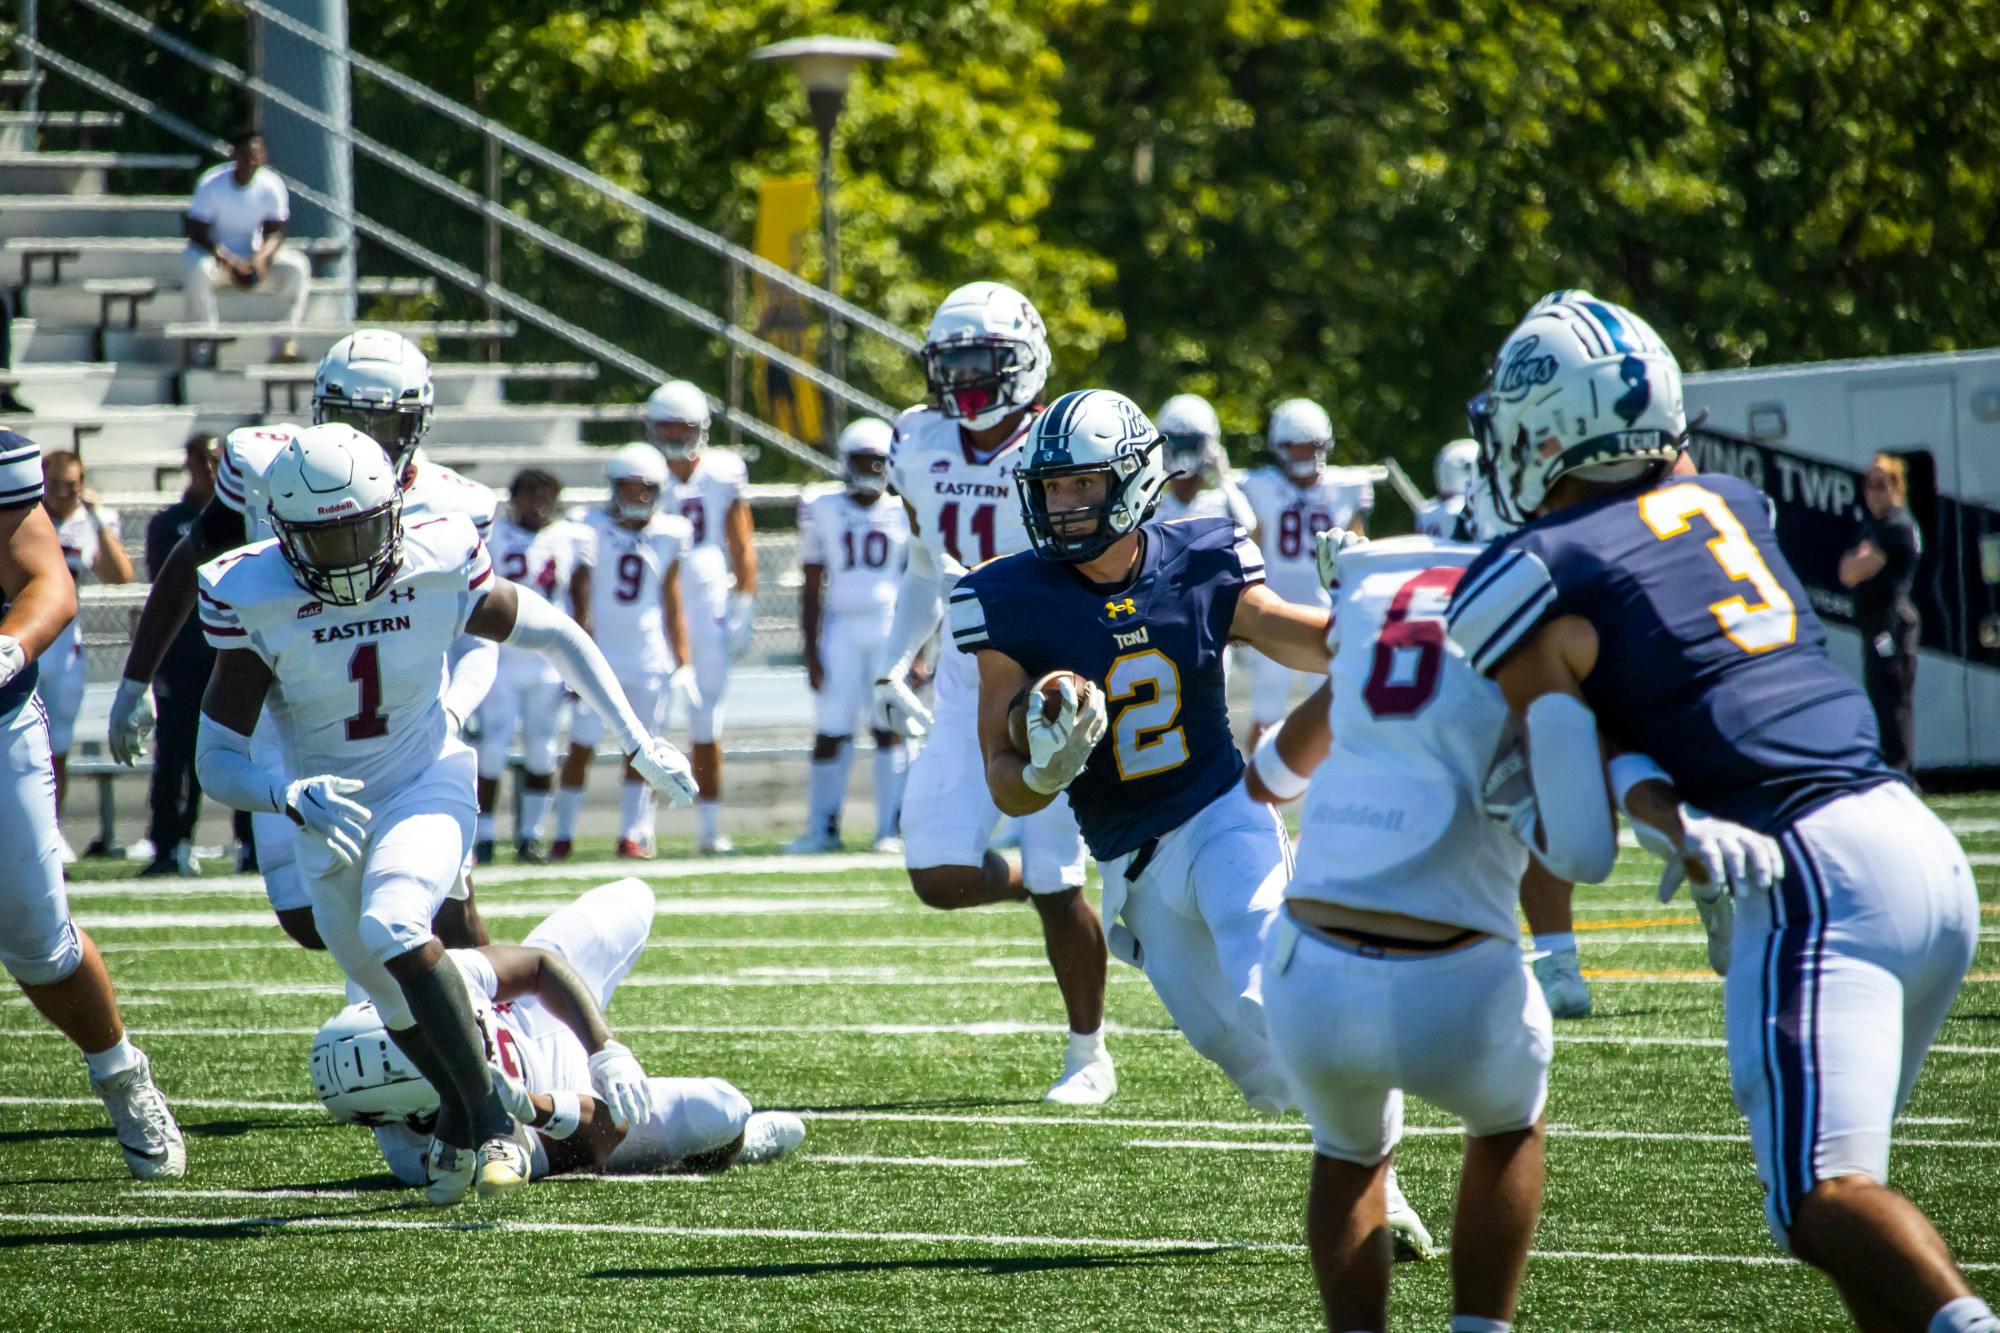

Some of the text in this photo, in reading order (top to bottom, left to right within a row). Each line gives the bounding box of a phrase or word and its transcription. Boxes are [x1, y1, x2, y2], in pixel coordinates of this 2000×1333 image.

[1492, 335, 1559, 402] Lions
[1576, 417, 1587, 436] 3
[1617, 431, 1660, 451] TCNJ
[317, 500, 353, 516] Riddell
[934, 482, 1009, 498] EASTERN
[1775, 455, 1864, 522] TWP.
[842, 530, 888, 569] 10
[937, 501, 997, 568] 11
[616, 553, 643, 602] 9
[1637, 483, 1797, 654] 3
[299, 606, 321, 618] MAC
[312, 616, 410, 644] EASTERN
[1113, 626, 1149, 650] TCNJ
[1361, 566, 1467, 722] 6
[344, 641, 389, 741] 1
[1105, 648, 1190, 781] 2
[1310, 803, 1407, 832] Riddell
